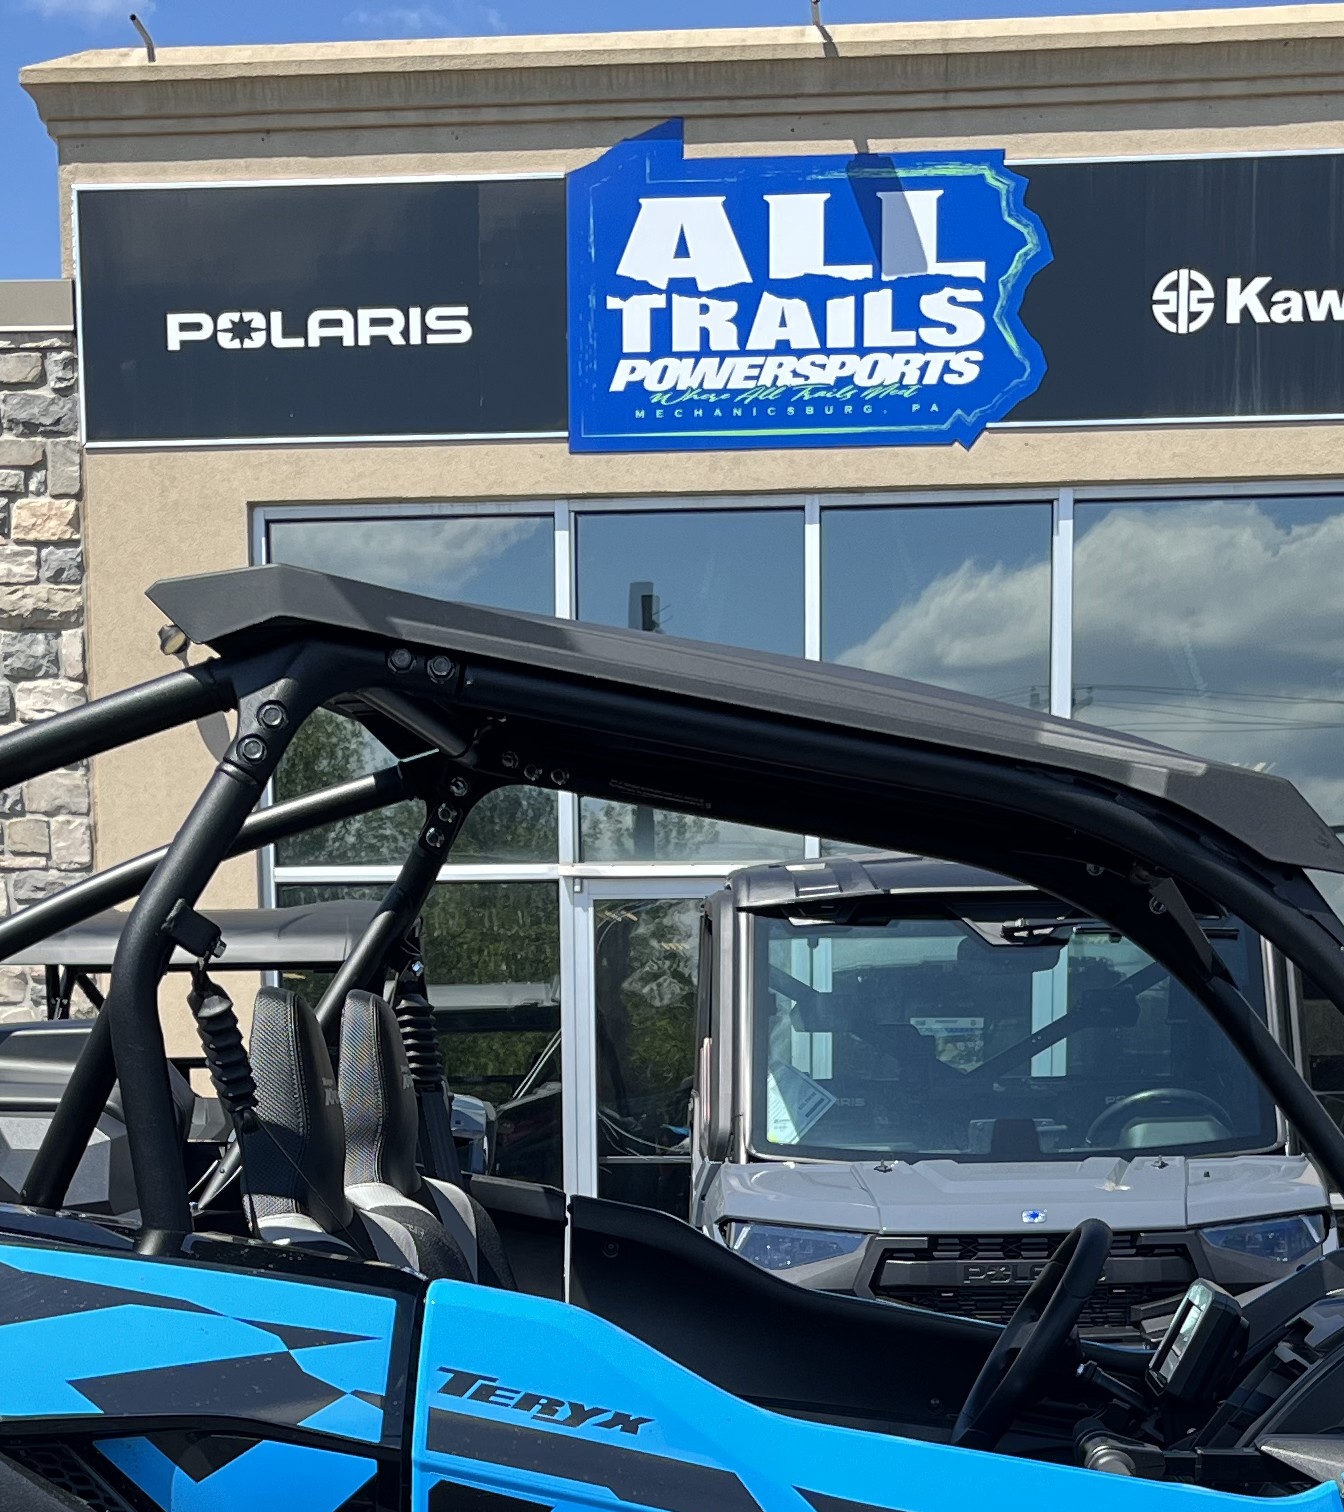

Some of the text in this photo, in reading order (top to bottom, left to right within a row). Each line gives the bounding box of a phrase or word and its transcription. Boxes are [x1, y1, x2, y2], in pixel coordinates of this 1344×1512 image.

[616, 189, 986, 291] ALL
[166, 306, 473, 351] POLARIS
[606, 287, 987, 352] TRAILS
[608, 351, 984, 392] POWERSPORTS
[649, 387, 732, 405] Where
[734, 385, 787, 404] All
[791, 384, 858, 402] Trails
[911, 402, 940, 414] PA
[437, 1366, 655, 1435] TERYX
